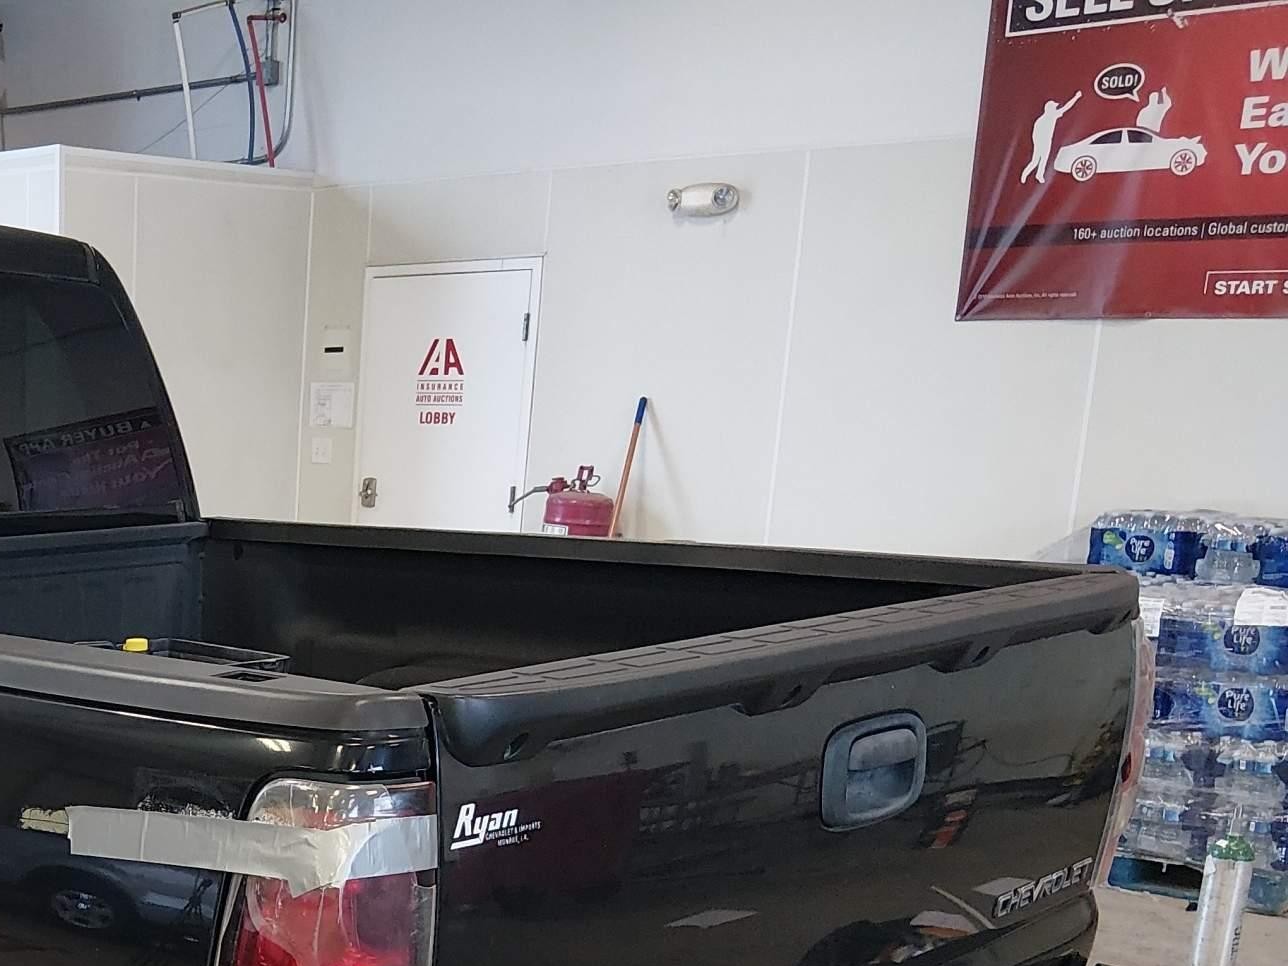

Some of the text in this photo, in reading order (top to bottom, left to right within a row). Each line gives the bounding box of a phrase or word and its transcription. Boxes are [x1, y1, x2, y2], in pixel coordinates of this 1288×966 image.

[1101, 74, 1139, 90] SOLD!
[1234, 142, 1287, 176] Yo
[1073, 228, 1097, 241] 160+
[1100, 228, 1141, 239] auction
[1143, 223, 1199, 237] locations
[1208, 221, 1248, 236] Global
[1214, 280, 1279, 295] START
[416, 383, 464, 391] INSURANCE
[416, 394, 463, 403] AUTO AUCTIONS
[419, 411, 456, 425] LOBBY
[1130, 536, 1151, 548] Pure
[1130, 544, 1147, 561] Life
[1231, 624, 1256, 636] Pure
[1233, 634, 1253, 647] Life
[1225, 689, 1250, 701] Pure
[1227, 699, 1246, 715] Life
[450, 803, 519, 850] Ryan
[996, 857, 1093, 917] CHEVROLET
